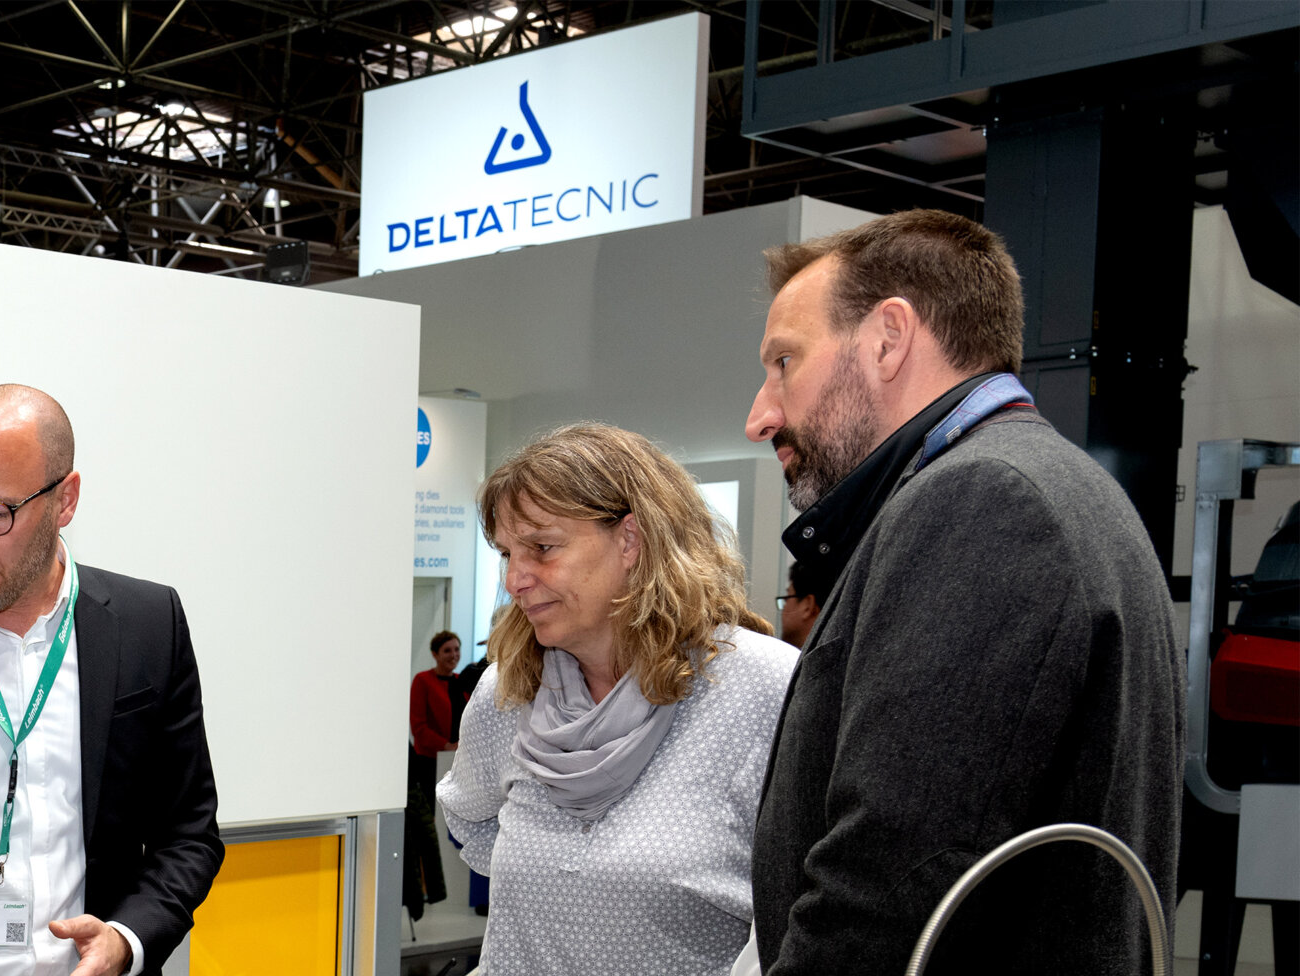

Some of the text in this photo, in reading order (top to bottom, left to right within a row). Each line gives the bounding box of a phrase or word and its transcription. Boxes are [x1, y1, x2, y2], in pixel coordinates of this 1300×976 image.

[386, 173, 659, 253] DELTATECNIC
[426, 489, 440, 500] dies
[420, 503, 449, 514] diamond
[450, 505, 465, 515] tools
[416, 532, 440, 542] service
[414, 556, 449, 568] es.com
